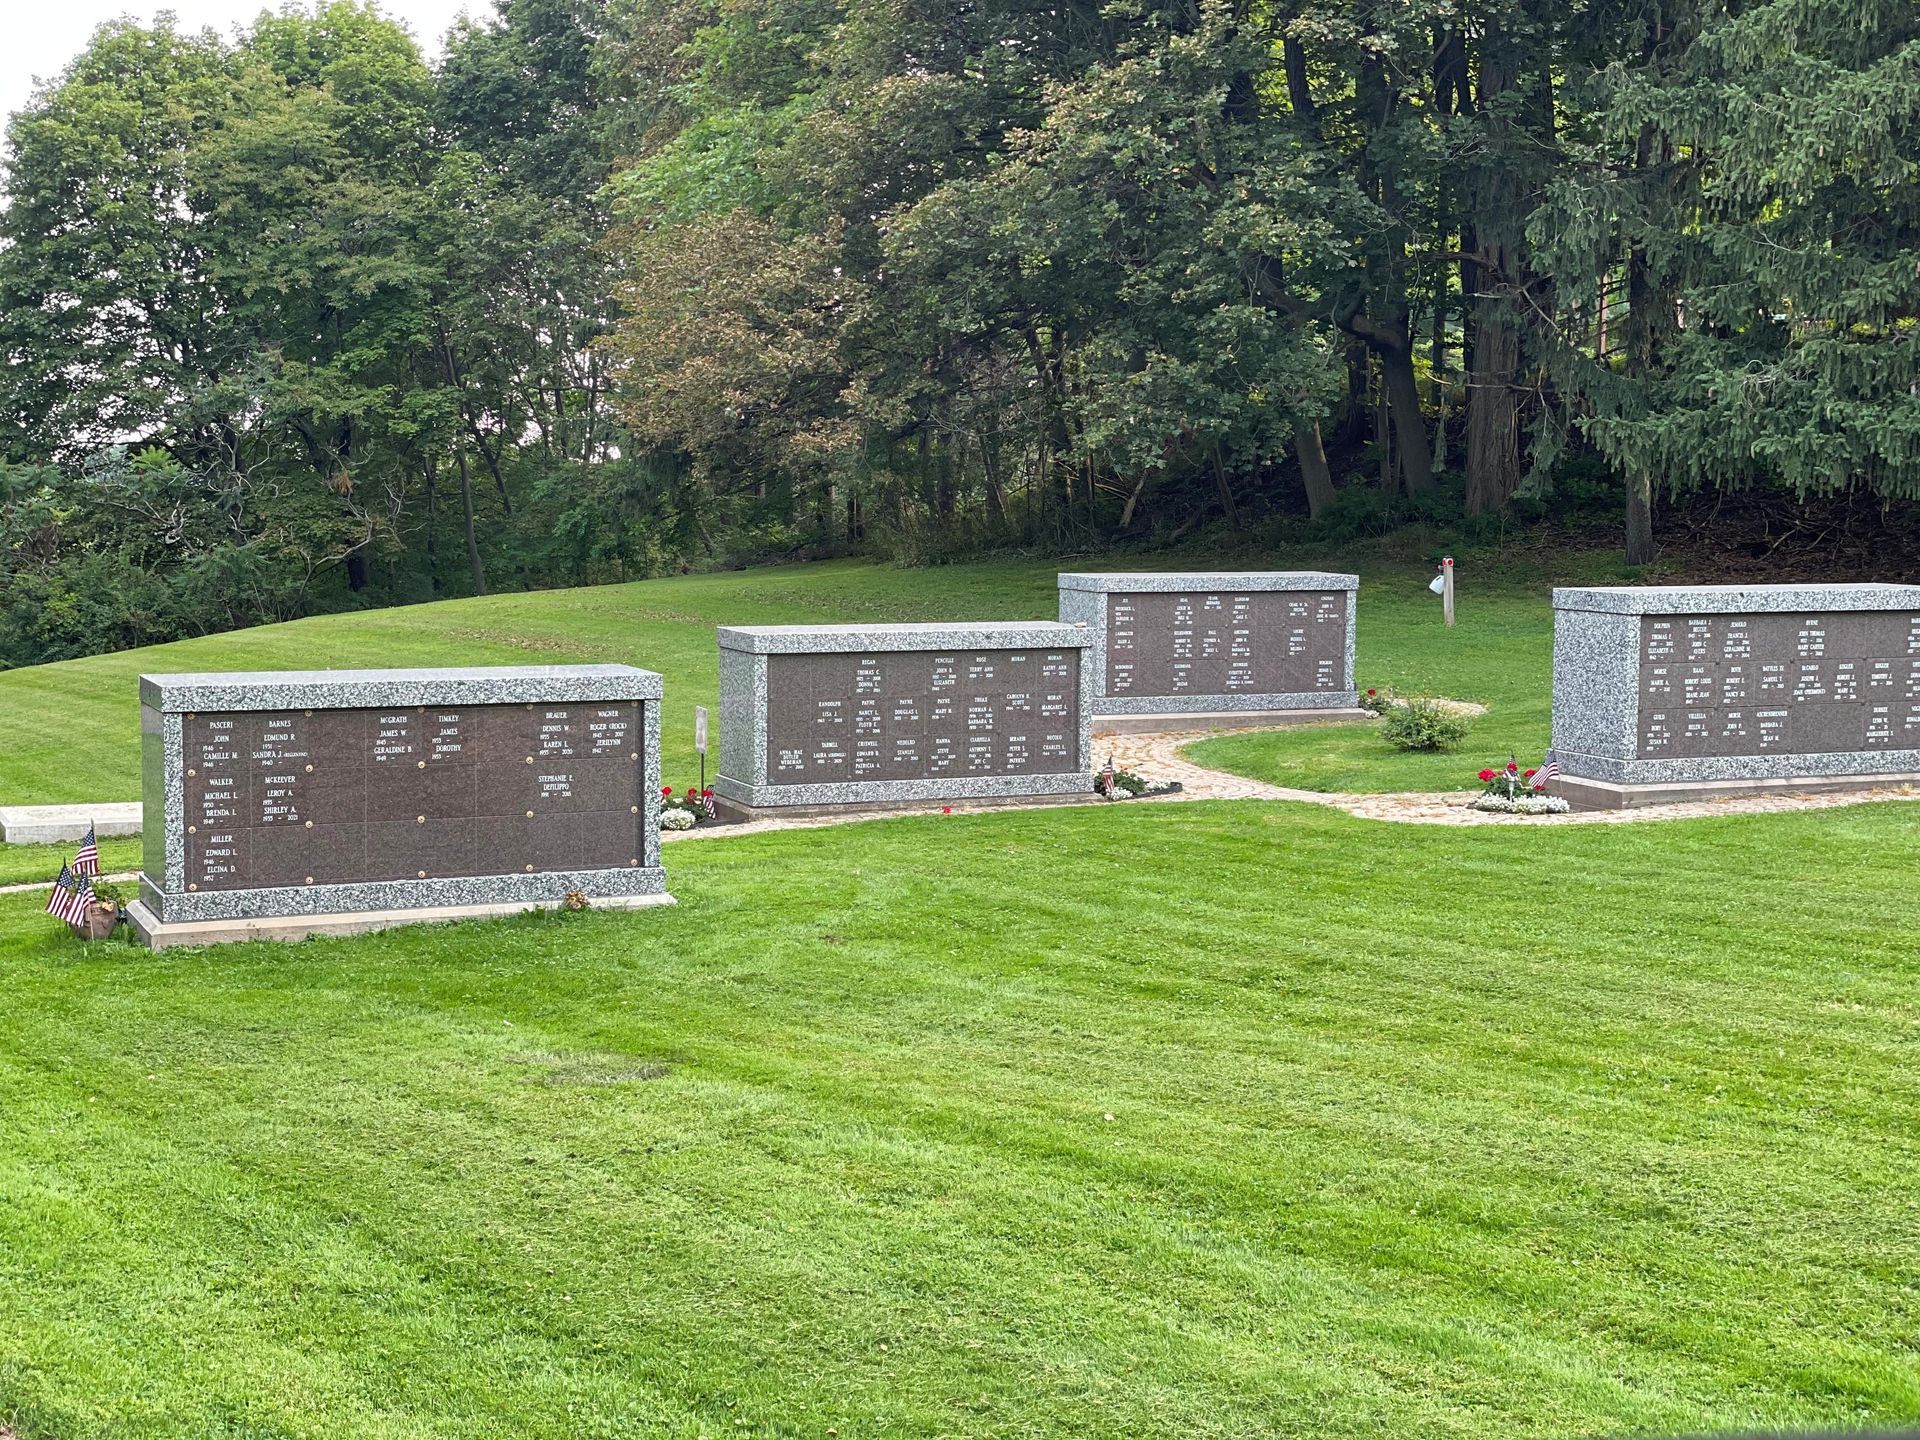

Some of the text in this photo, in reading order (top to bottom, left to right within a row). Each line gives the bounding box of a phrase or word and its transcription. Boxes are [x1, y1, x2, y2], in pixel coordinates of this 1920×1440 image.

[597, 710, 619, 718] WAGNER
[209, 721, 233, 729] PASCERI
[269, 720, 291, 728] BARNES
[379, 729, 399, 738] JAMES
[439, 728, 458, 736] JAMES
[213, 735, 230, 743] JOHN
[264, 734, 288, 742] EDMUND
[373, 746, 405, 754] GERALDINE
[435, 744, 462, 753] DOROTHY
[203, 752, 229, 760] CAMILLE
[252, 751, 276, 759] SANDRA
[209, 778, 233, 786] WALKER
[204, 792, 231, 800] MICHAEL
[206, 809, 230, 817] BRENDA
[263, 806, 288, 815] SHIRLEY
[210, 835, 233, 843] MILLER
[205, 849, 231, 857] EDWARD
